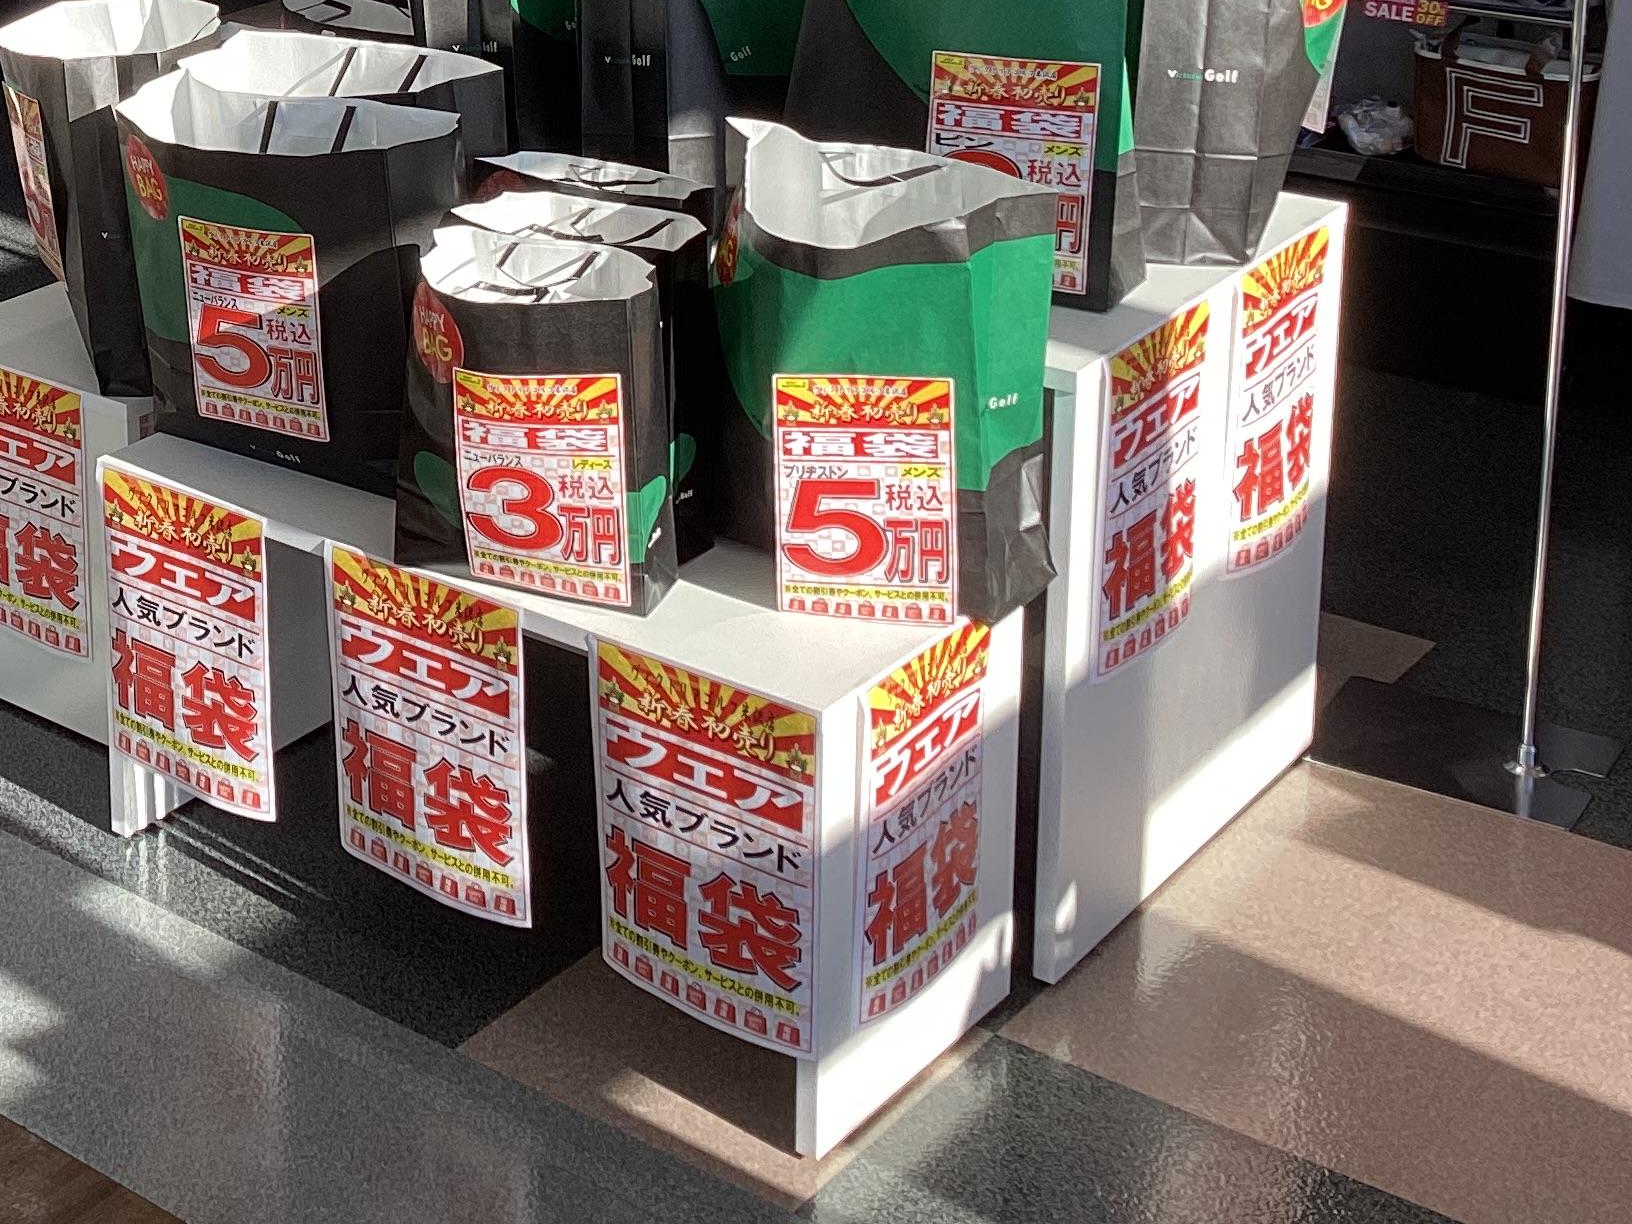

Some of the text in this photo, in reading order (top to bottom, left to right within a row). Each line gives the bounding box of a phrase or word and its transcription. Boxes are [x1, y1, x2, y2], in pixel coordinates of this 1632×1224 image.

[1365, 2, 1413, 23] SALE
[1416, 12, 1444, 26] OFF
[730, 45, 753, 62] Golf
[1204, 68, 1239, 84] Golf
[965, 79, 1067, 107] 新春初売り
[936, 103, 1083, 140] 福袋
[936, 133, 1084, 157] ピン メンズ
[131, 155, 156, 176] HAPPY
[1028, 159, 1082, 188] 税込
[136, 174, 163, 202] BAG
[208, 247, 289, 273] 新春初売り
[191, 265, 306, 302] 福袋
[192, 291, 309, 318] ニューバランス メンズ
[266, 318, 313, 346] 税込
[419, 307, 447, 332] HAPPY
[195, 304, 320, 406] 5万円
[423, 334, 453, 363] BAG
[1242, 343, 1318, 423] 人気ブランド
[485, 399, 589, 422] 新春初売り
[810, 402, 920, 426] 新春初売り
[988, 392, 1020, 411] Golf
[464, 422, 608, 452] 福袋
[783, 431, 939, 459] 福袋
[275, 450, 301, 463] Golf
[463, 451, 613, 470] ニューバランス レディース
[1110, 427, 1199, 514] 人気ブランド
[1232, 392, 1315, 522] 福袋
[558, 474, 615, 501] 税込
[901, 467, 942, 479] メンズ
[885, 484, 944, 512] 税込
[466, 465, 622, 566] 3万円
[134, 507, 236, 565] 新春初売り
[782, 479, 950, 584] 5万円
[1102, 478, 1196, 619] 福袋
[111, 587, 256, 659] 人気ブランド
[367, 594, 487, 656] 新春初売り
[111, 627, 260, 764] 福袋
[342, 675, 510, 758] 人気ブランド
[638, 690, 776, 763] 新春初売り
[341, 718, 514, 865] 福袋
[873, 747, 978, 856] 人気ブランド
[606, 778, 803, 874] 人気ブランド
[865, 801, 979, 967] 福袋
[605, 826, 804, 994] 福袋
